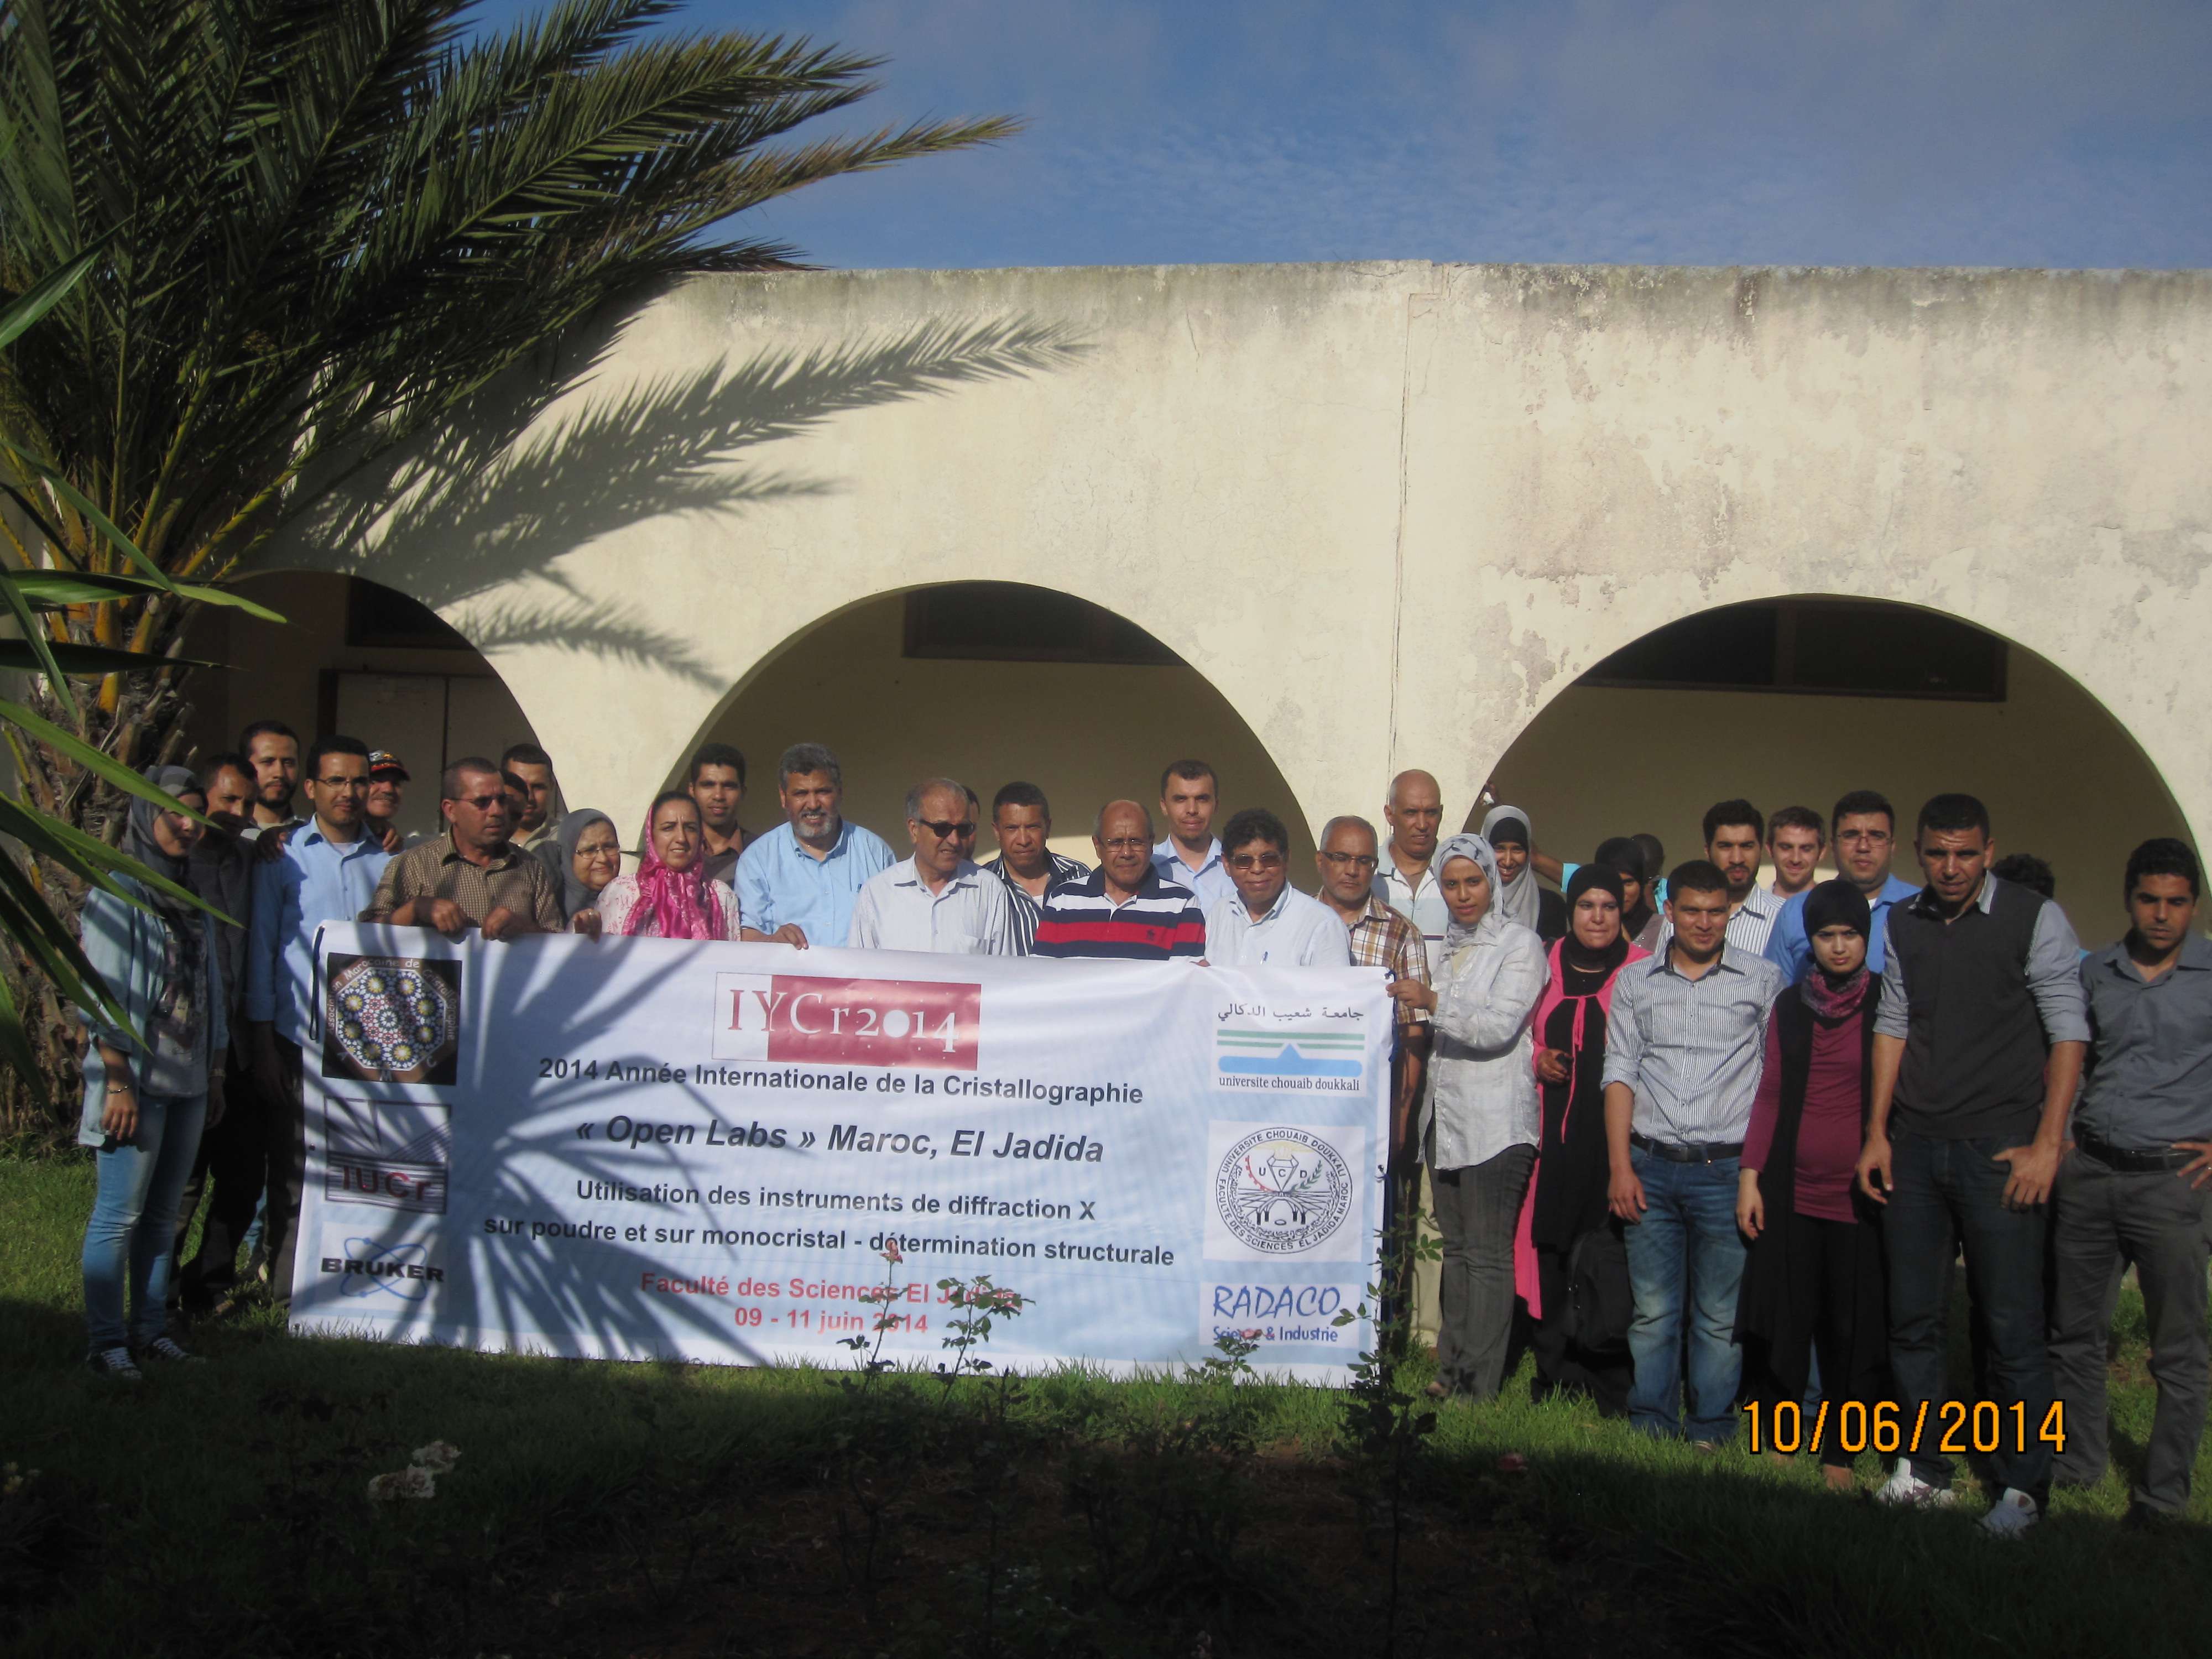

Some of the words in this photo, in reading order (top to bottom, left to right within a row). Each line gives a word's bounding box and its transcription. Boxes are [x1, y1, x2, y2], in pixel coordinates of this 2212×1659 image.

[405, 958, 420, 968] de
[1273, 1007, 1312, 1021] شعيب
[1322, 1006, 1364, 1021] جامعة
[539, 1058, 598, 1080] 2014
[606, 1061, 687, 1084] Année
[695, 1065, 868, 1092] Internationale
[877, 1072, 906, 1093] de
[915, 1074, 935, 1095] la
[943, 1076, 1144, 1106] Cristallographie
[1219, 1076, 1269, 1088] universite
[1272, 1078, 1312, 1089] chouaib
[1316, 1079, 1359, 1091] doukkali
[606, 1115, 695, 1149] Open
[706, 1120, 787, 1149] Labs
[828, 1124, 937, 1159] Maroc,
[950, 1130, 983, 1157] El
[993, 1132, 1104, 1162] Jadida
[1222, 1133, 1263, 1173] UNIVERSITE
[1266, 1130, 1308, 1143] CHOUAIB
[1311, 1140, 1346, 1177] DOUKKALI
[342, 1165, 431, 1201] IUCr
[1259, 1167, 1266, 1176] U
[1278, 1169, 1286, 1177] C
[1300, 1170, 1307, 1178] D
[577, 1180, 699, 1204] Utilisation
[708, 1183, 750, 1206] des
[760, 1187, 902, 1211] instruments
[911, 1192, 940, 1213] de
[948, 1194, 1071, 1219] diffraction
[1079, 1201, 1095, 1220] X
[1218, 1178, 1232, 1220] FACULTE
[1230, 1219, 1245, 1237] DES
[1245, 1235, 1293, 1250] SCIENCES
[1313, 1216, 1340, 1241] JADIDA
[1339, 1182, 1348, 1215] MAROC
[484, 1218, 524, 1236] sur
[531, 1219, 616, 1241] poudre
[624, 1224, 647, 1243] et
[654, 1227, 694, 1244] sur
[702, 1228, 846, 1250] monocristal
[869, 1232, 1035, 1257] détermination
[1044, 1240, 1174, 1266] structurale
[321, 1257, 444, 1282] BRUKER
[641, 1272, 728, 1296] Faculté
[737, 1277, 780, 1297] des
[907, 1283, 928, 1303] El
[1213, 1286, 1340, 1319] RADACO
[734, 1307, 762, 1327] 09
[786, 1309, 810, 1330] 11
[818, 1311, 863, 1335] juin
[1280, 1326, 1338, 1342] Industrie
